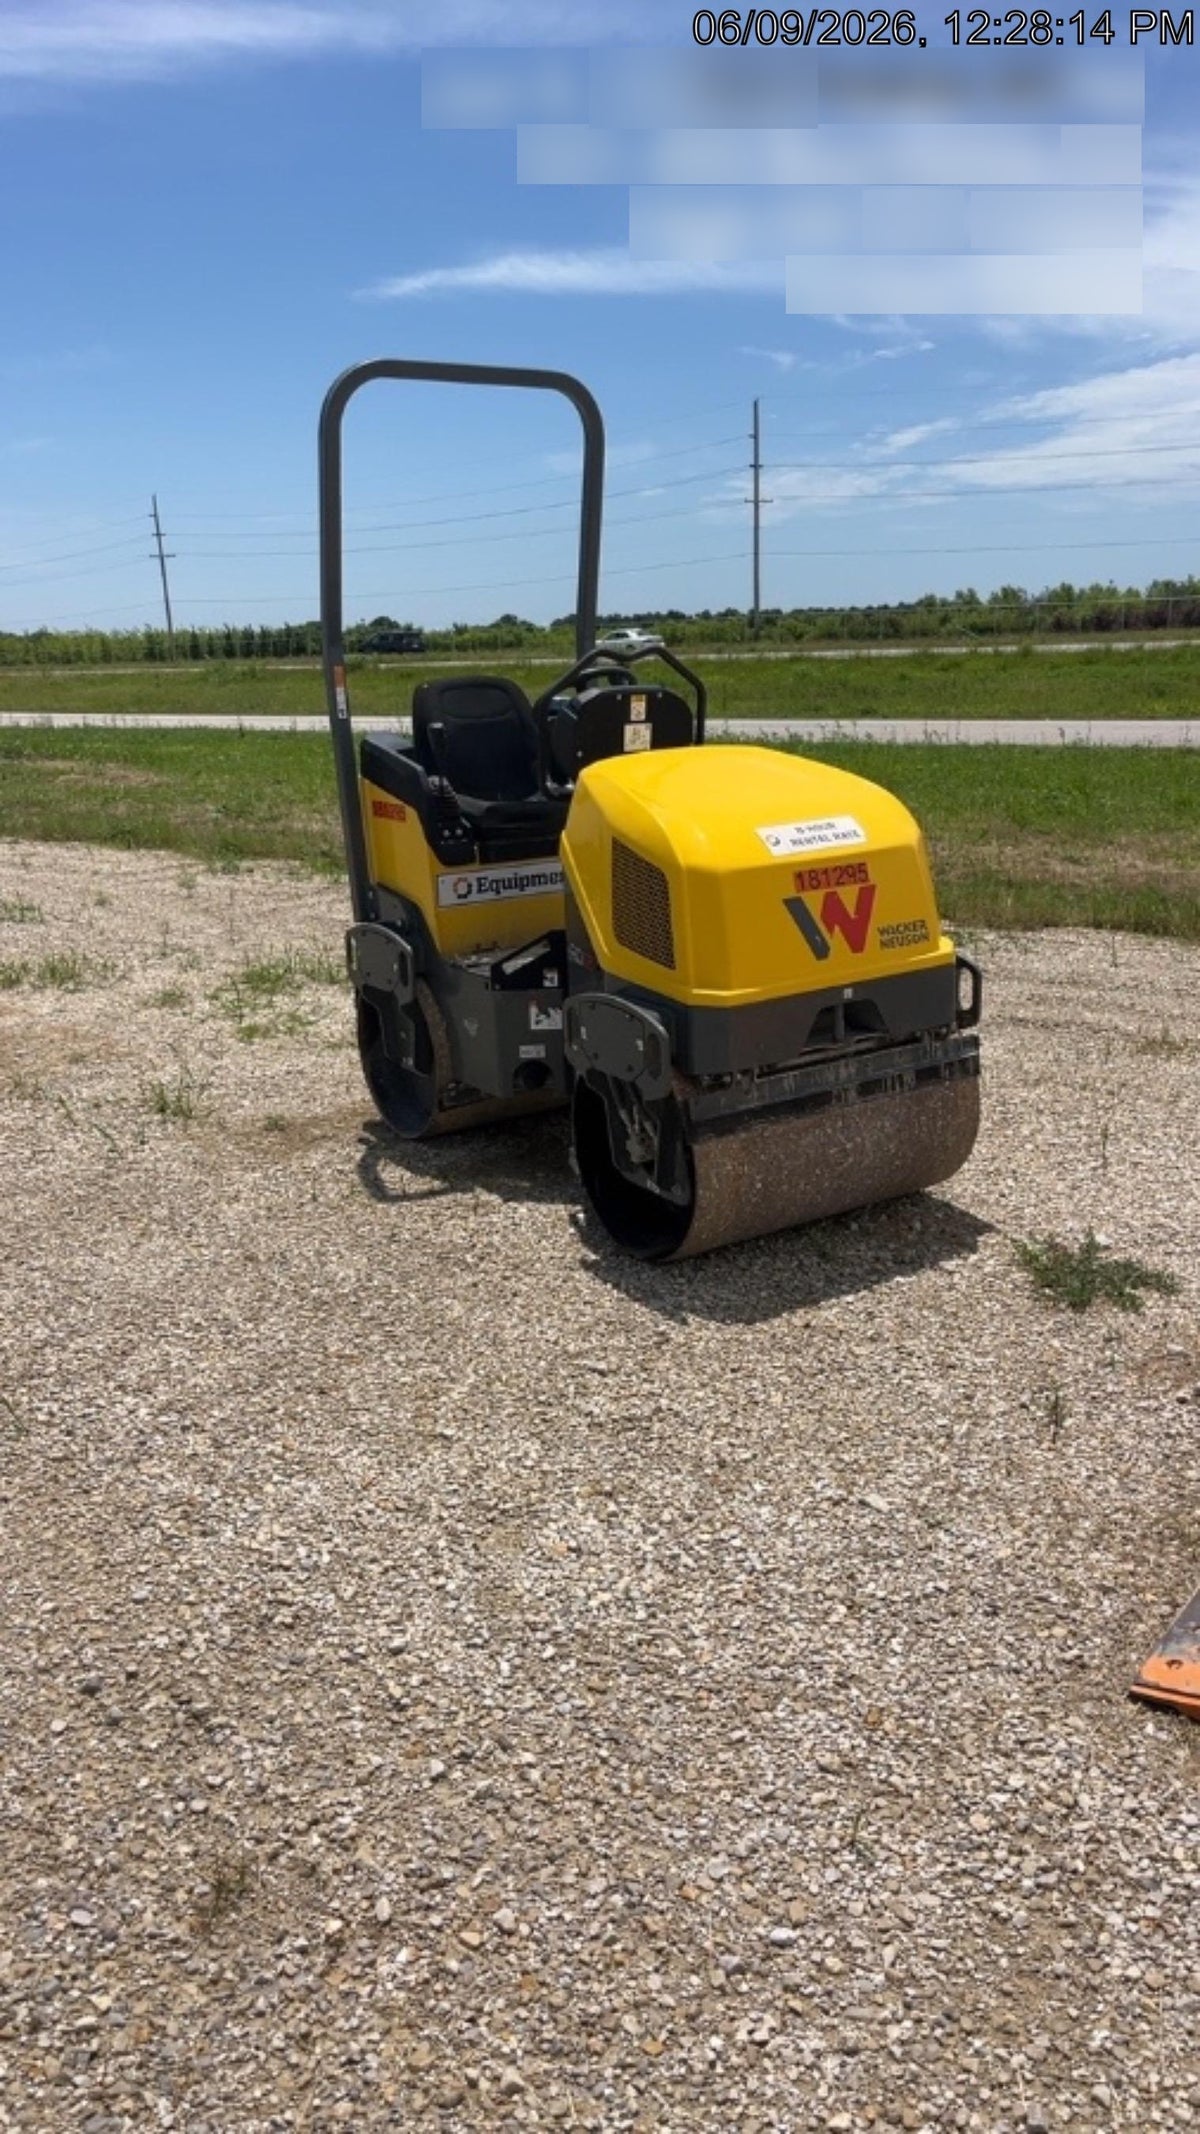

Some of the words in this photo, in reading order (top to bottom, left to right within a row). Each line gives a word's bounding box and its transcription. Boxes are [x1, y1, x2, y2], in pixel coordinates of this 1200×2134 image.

[789, 833, 832, 847] RENTAL
[832, 828, 861, 841] RATE
[796, 863, 869, 890] 181295
[877, 919, 928, 936] WACKER
[879, 932, 930, 950] NEUSON
